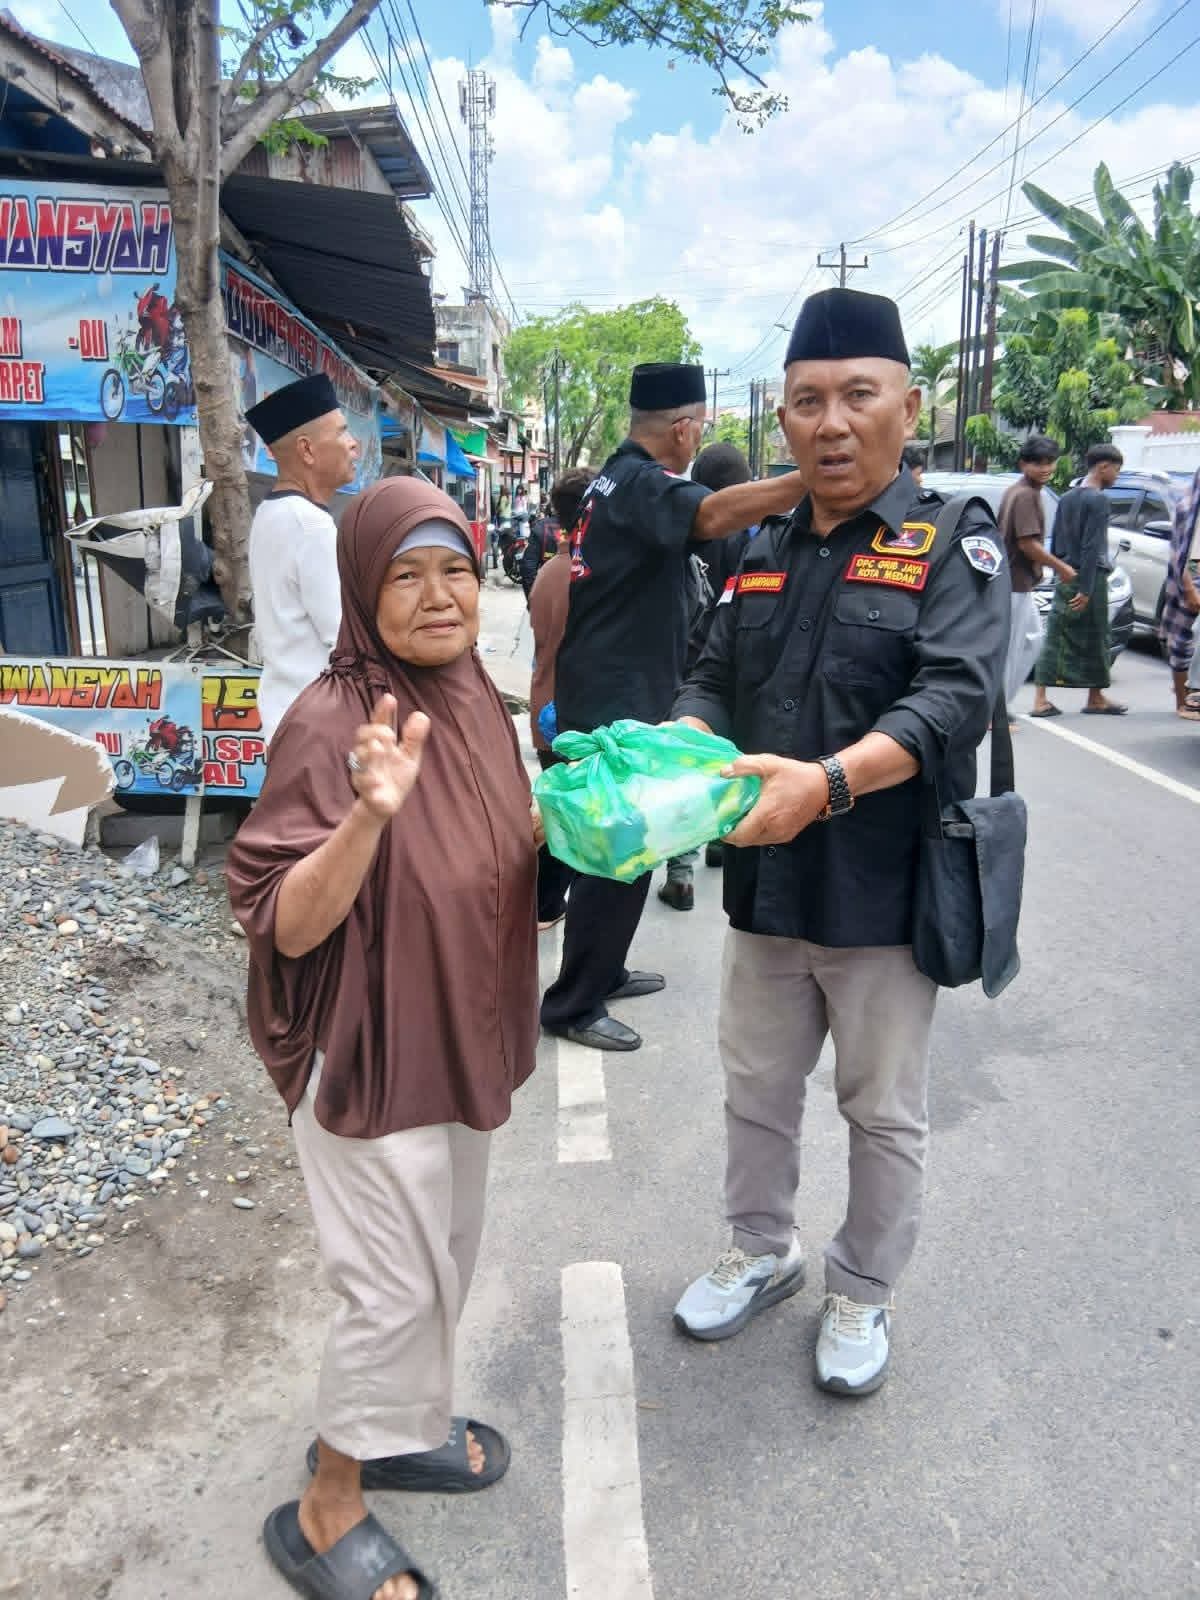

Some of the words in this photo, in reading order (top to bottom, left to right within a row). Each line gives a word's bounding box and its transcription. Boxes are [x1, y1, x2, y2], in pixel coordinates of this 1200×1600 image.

[0, 196, 174, 274] ANSYAH
[0, 316, 21, 357] M
[856, 558, 876, 568] DPC
[901, 562, 923, 575] JAYA
[857, 567, 880, 578] KOTA
[883, 569, 917, 585] MEDAN
